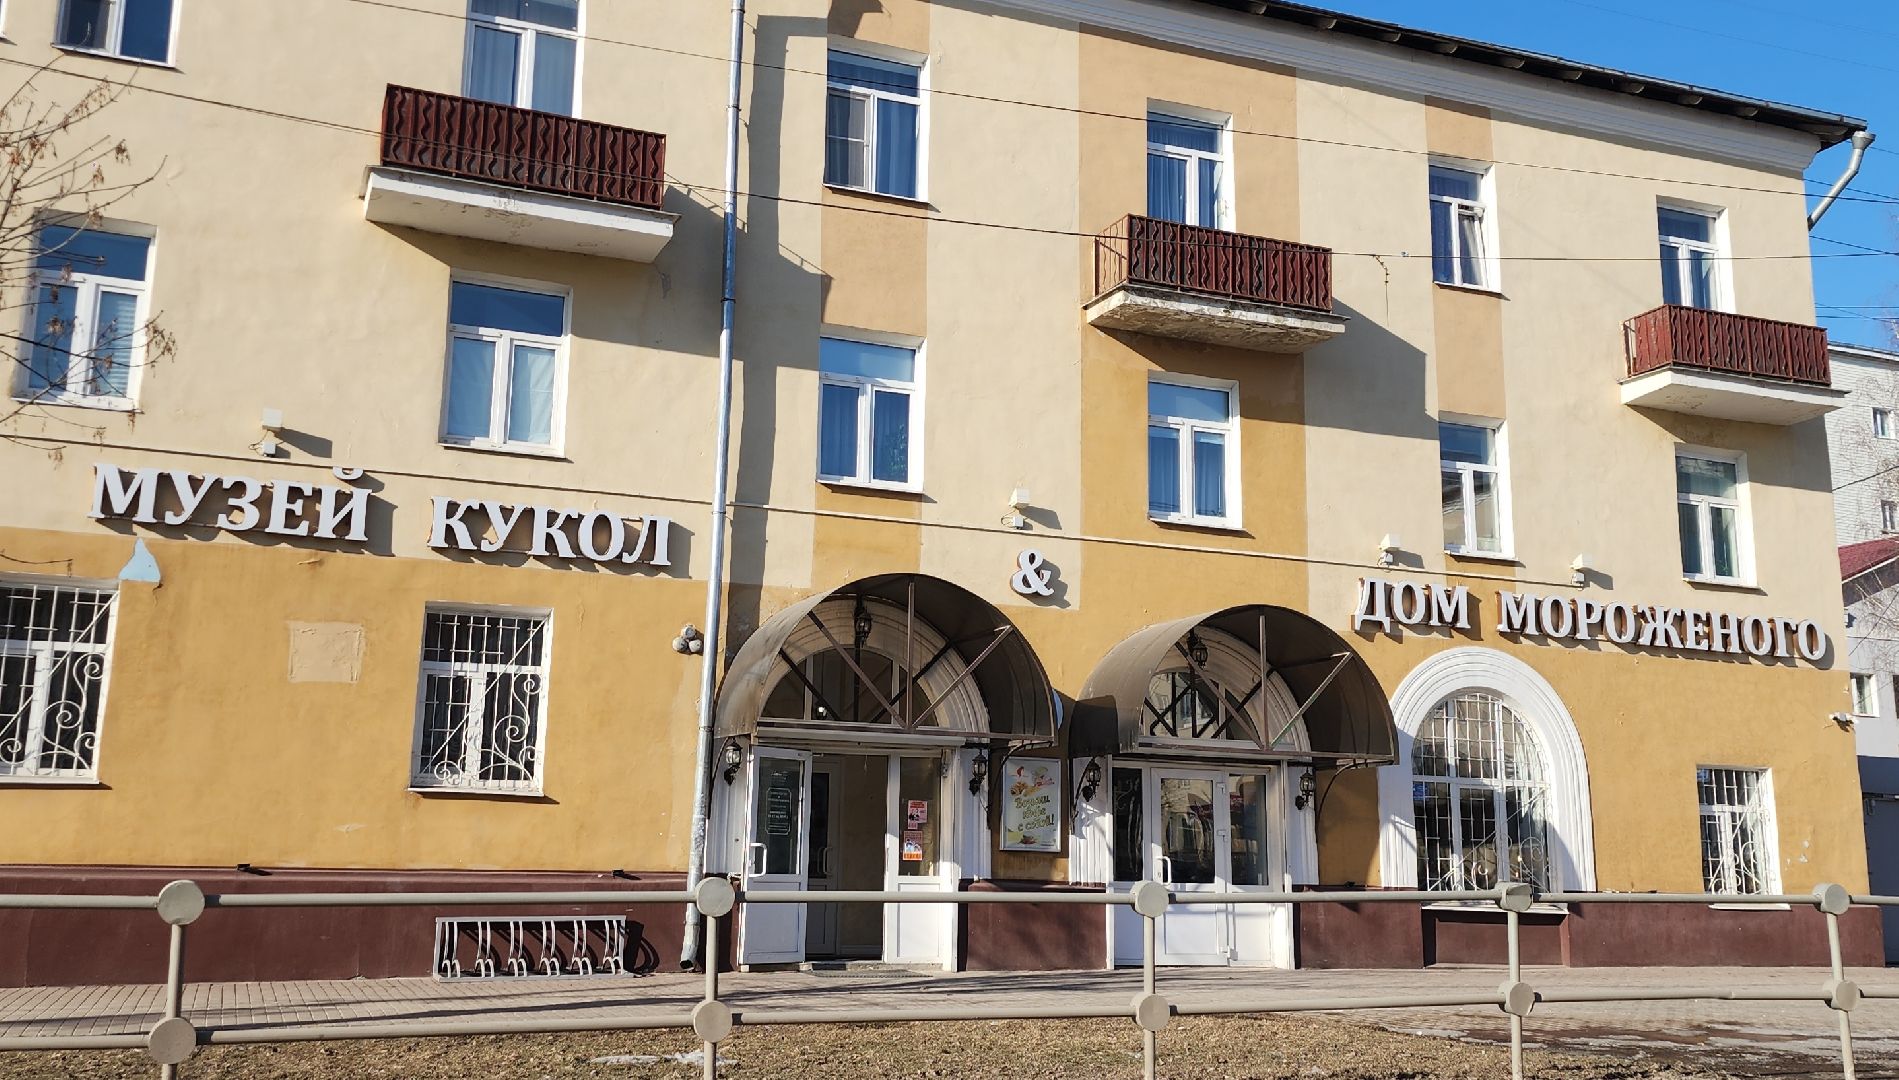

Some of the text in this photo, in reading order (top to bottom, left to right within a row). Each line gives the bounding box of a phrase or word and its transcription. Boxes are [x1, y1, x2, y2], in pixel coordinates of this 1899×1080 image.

[87, 463, 672, 566] МУЗЕЙ КУКОЛ
[1011, 548, 1055, 596] &
[1352, 577, 1826, 660] ДОМ МОРОЖЕНОГО
